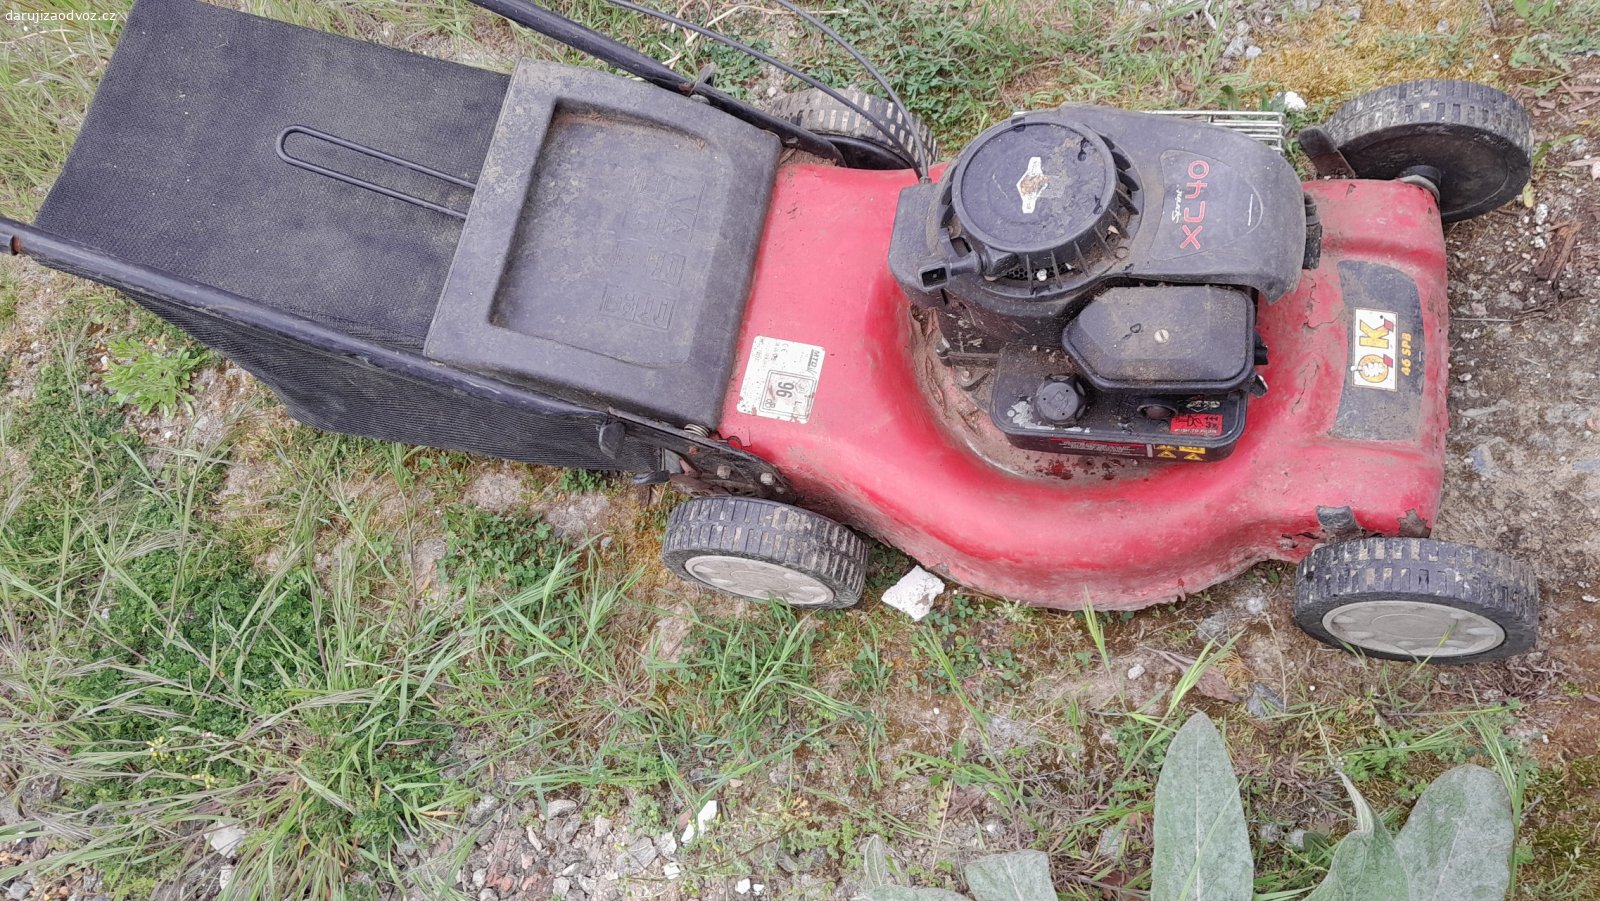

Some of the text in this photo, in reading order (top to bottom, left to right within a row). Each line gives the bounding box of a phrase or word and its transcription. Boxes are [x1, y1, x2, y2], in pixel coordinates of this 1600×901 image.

[1171, 189, 1183, 224] Sprint
[1400, 357, 1412, 377] 46
[775, 381, 795, 398] 96
